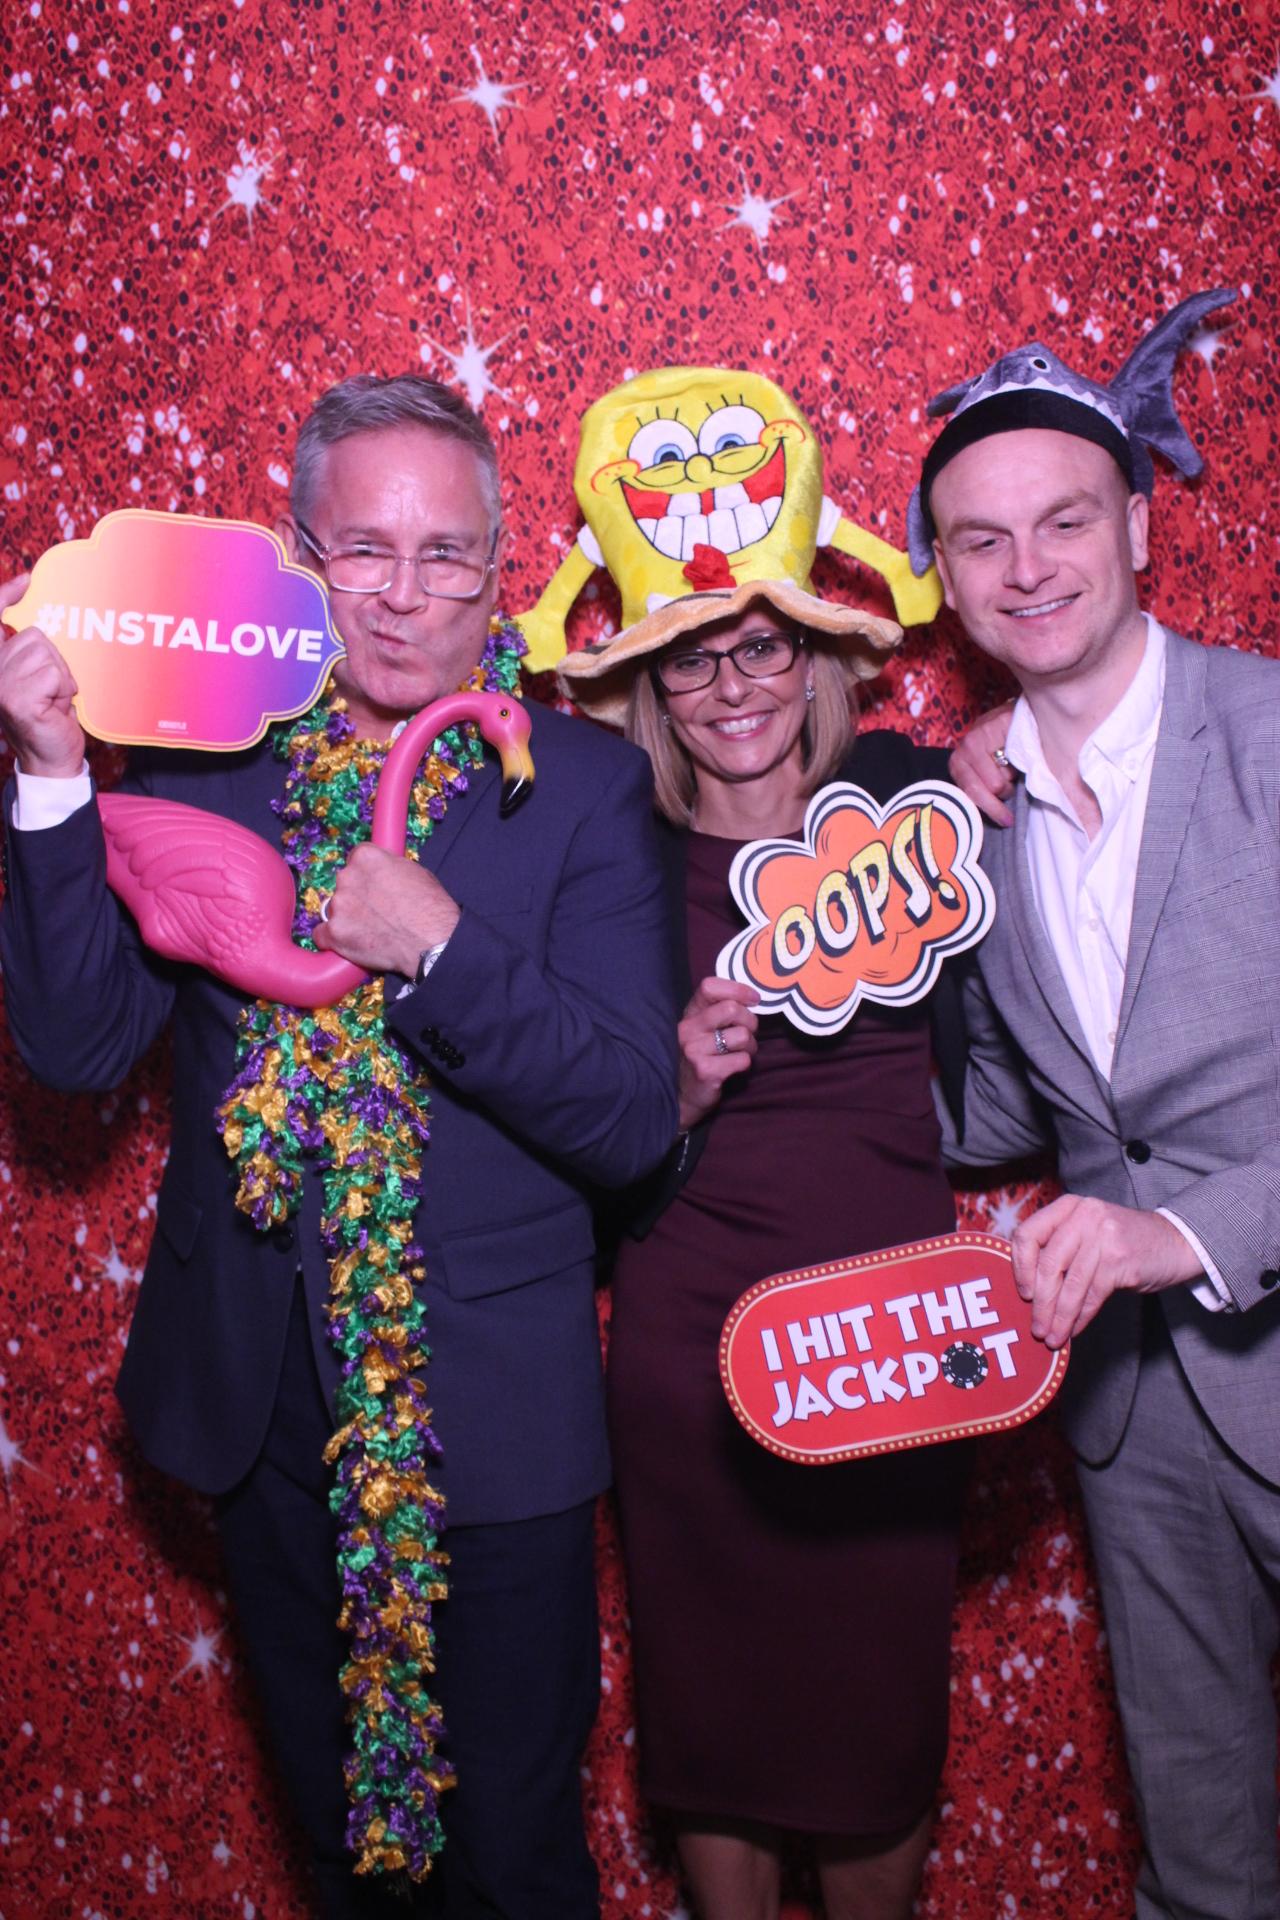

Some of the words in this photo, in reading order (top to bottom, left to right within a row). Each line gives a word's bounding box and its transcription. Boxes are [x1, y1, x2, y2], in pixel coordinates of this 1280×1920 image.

[36, 604, 323, 662] #INSTALOVE
[772, 801, 960, 976] OOPS!
[760, 1328, 783, 1372] I
[786, 1304, 873, 1365] HIT
[884, 1277, 1000, 1342] THE
[771, 1329, 1020, 1427] JACKPOT
